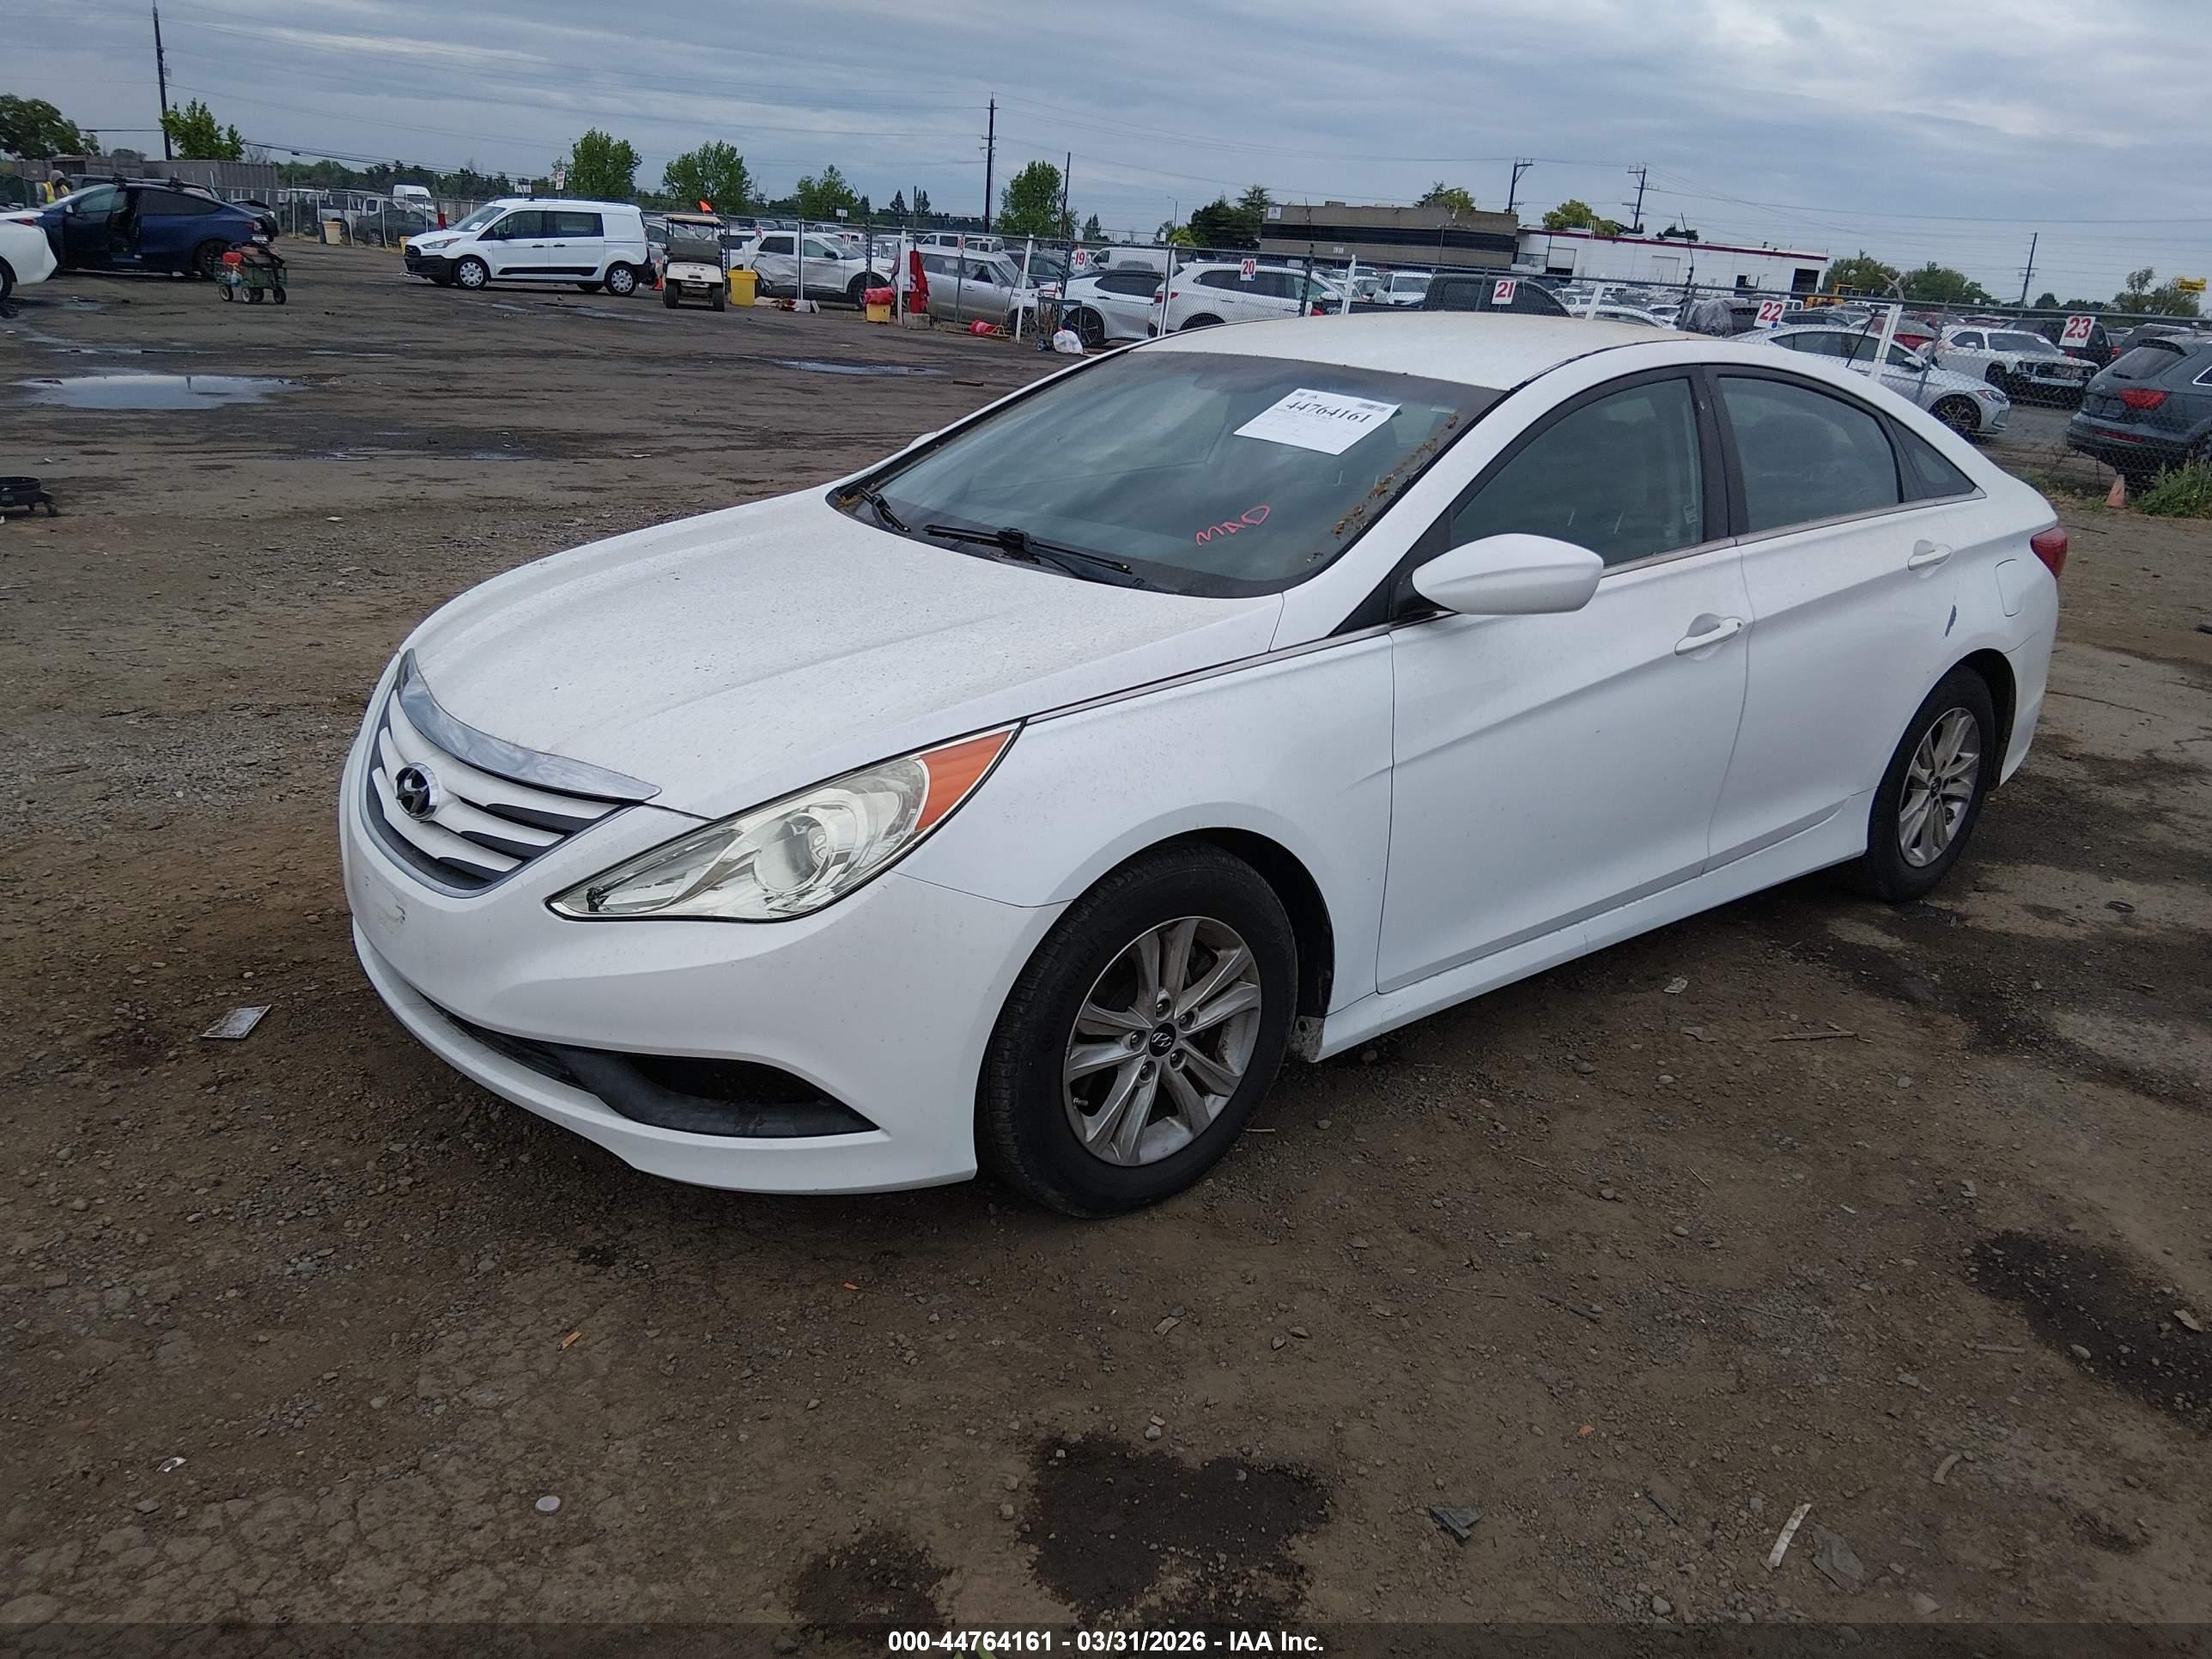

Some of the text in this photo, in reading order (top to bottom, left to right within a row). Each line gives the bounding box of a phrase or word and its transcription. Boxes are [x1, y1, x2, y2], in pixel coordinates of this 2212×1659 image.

[756, 227, 763, 239] 16
[843, 233, 851, 245] 17
[1075, 252, 1085, 265] 19
[1242, 260, 1255, 275] 20
[1495, 282, 1514, 298] 21
[1759, 302, 1783, 321] 22
[2064, 317, 2091, 338] 23
[1286, 401, 1373, 423] 44764161
